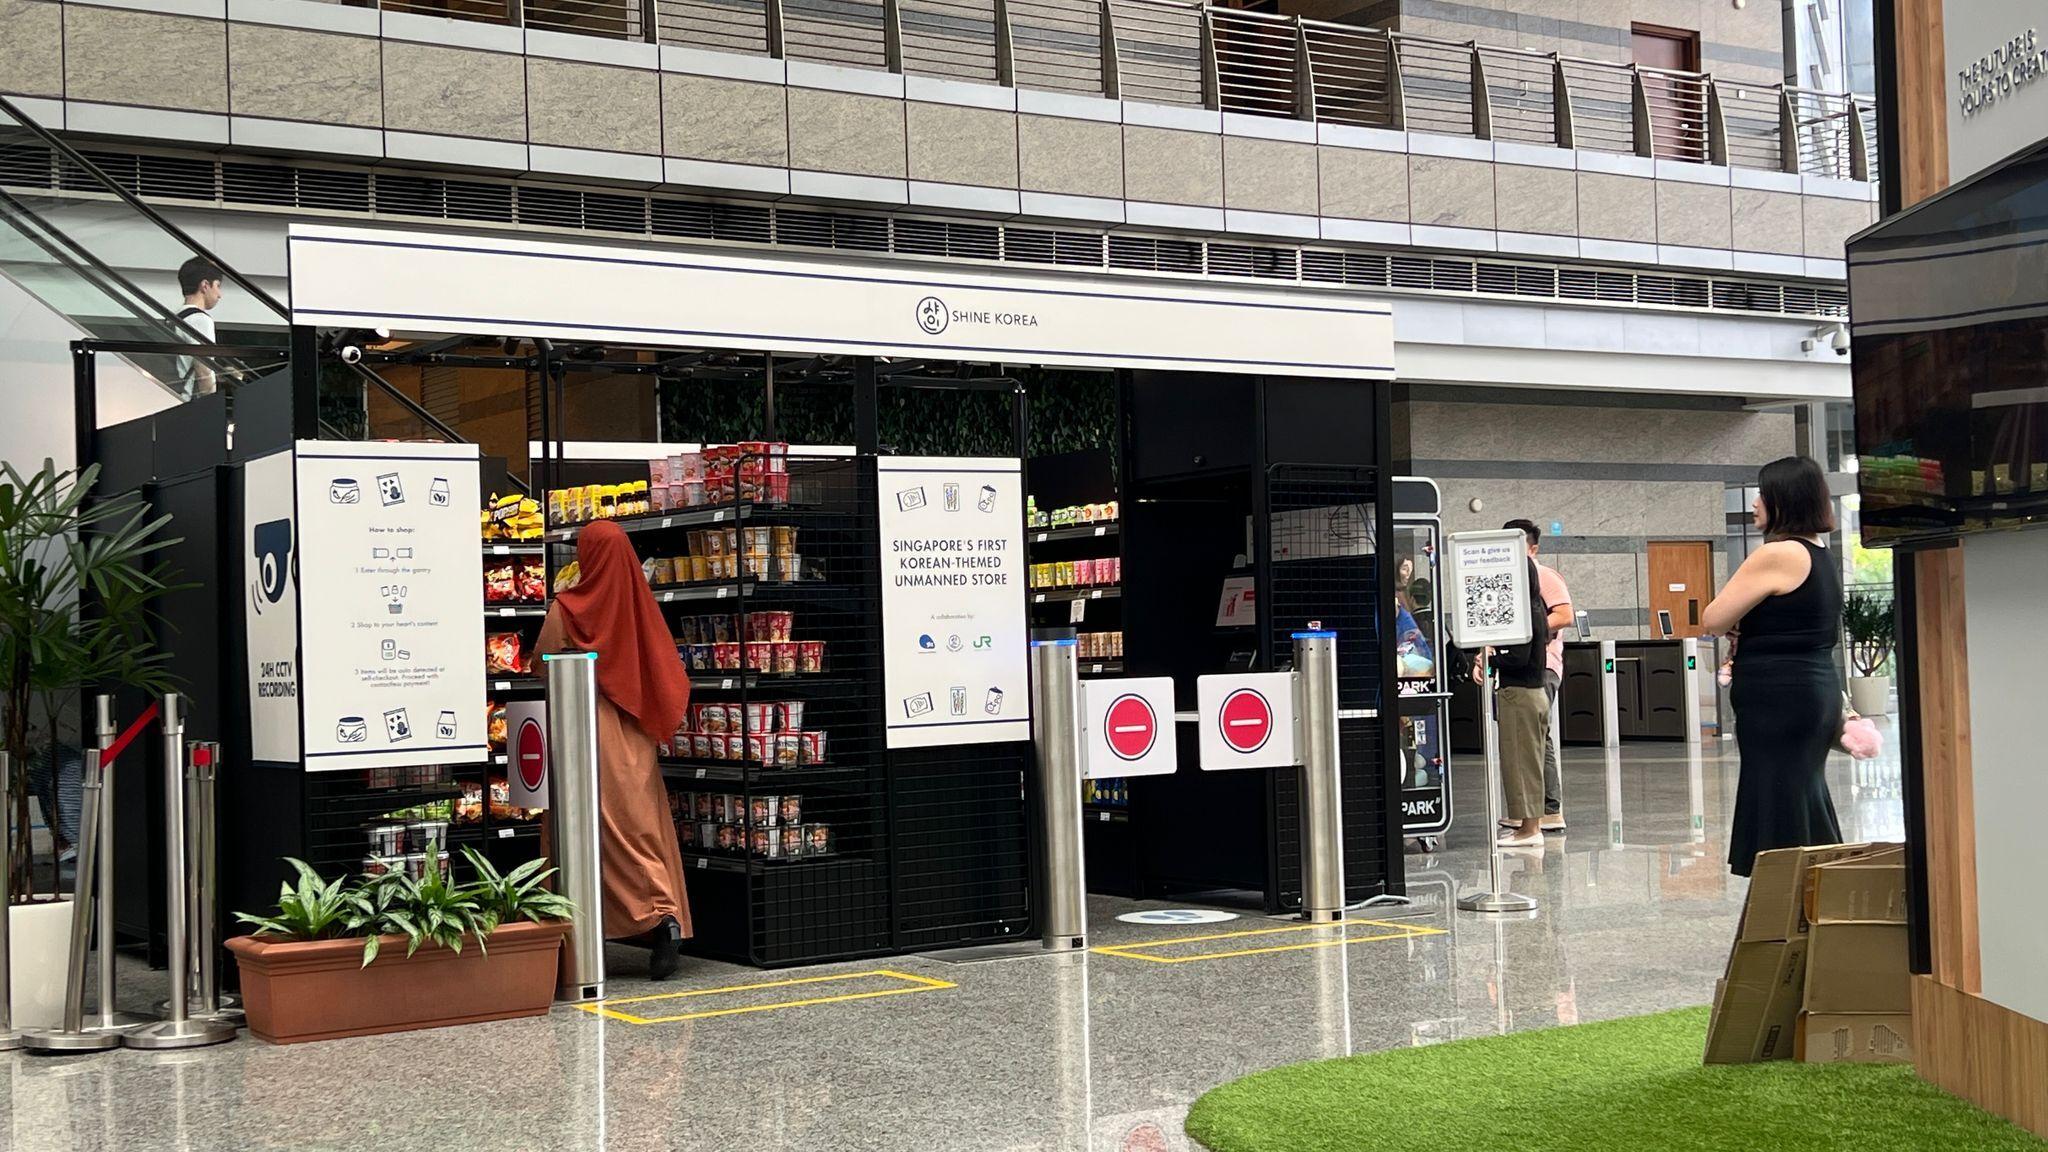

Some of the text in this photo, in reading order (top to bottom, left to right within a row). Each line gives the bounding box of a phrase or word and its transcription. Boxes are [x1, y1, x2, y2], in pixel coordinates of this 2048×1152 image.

[1959, 29, 2034, 91] THE FUTURE IS
[1959, 49, 2048, 116] YOURS TO CREAT
[952, 310, 1038, 327] SHINE KOREA
[369, 526, 385, 534] How
[396, 526, 415, 534] shop:
[893, 539, 1007, 552] SINGAPORE'S FIRST
[1463, 547, 1479, 556] Scan
[1481, 547, 1487, 555] &
[1487, 546, 1502, 555] give
[900, 556, 1001, 569] KOREAN-THEMED
[1463, 555, 1511, 566] your feedback
[377, 566, 399, 575] through
[412, 567, 431, 575] gantry
[895, 573, 1007, 587] UNMANNED STORE
[356, 621, 372, 629] Shop
[973, 635, 992, 648] JR
[261, 661, 292, 678] 24H CCTV
[258, 681, 296, 697] RECORDING
